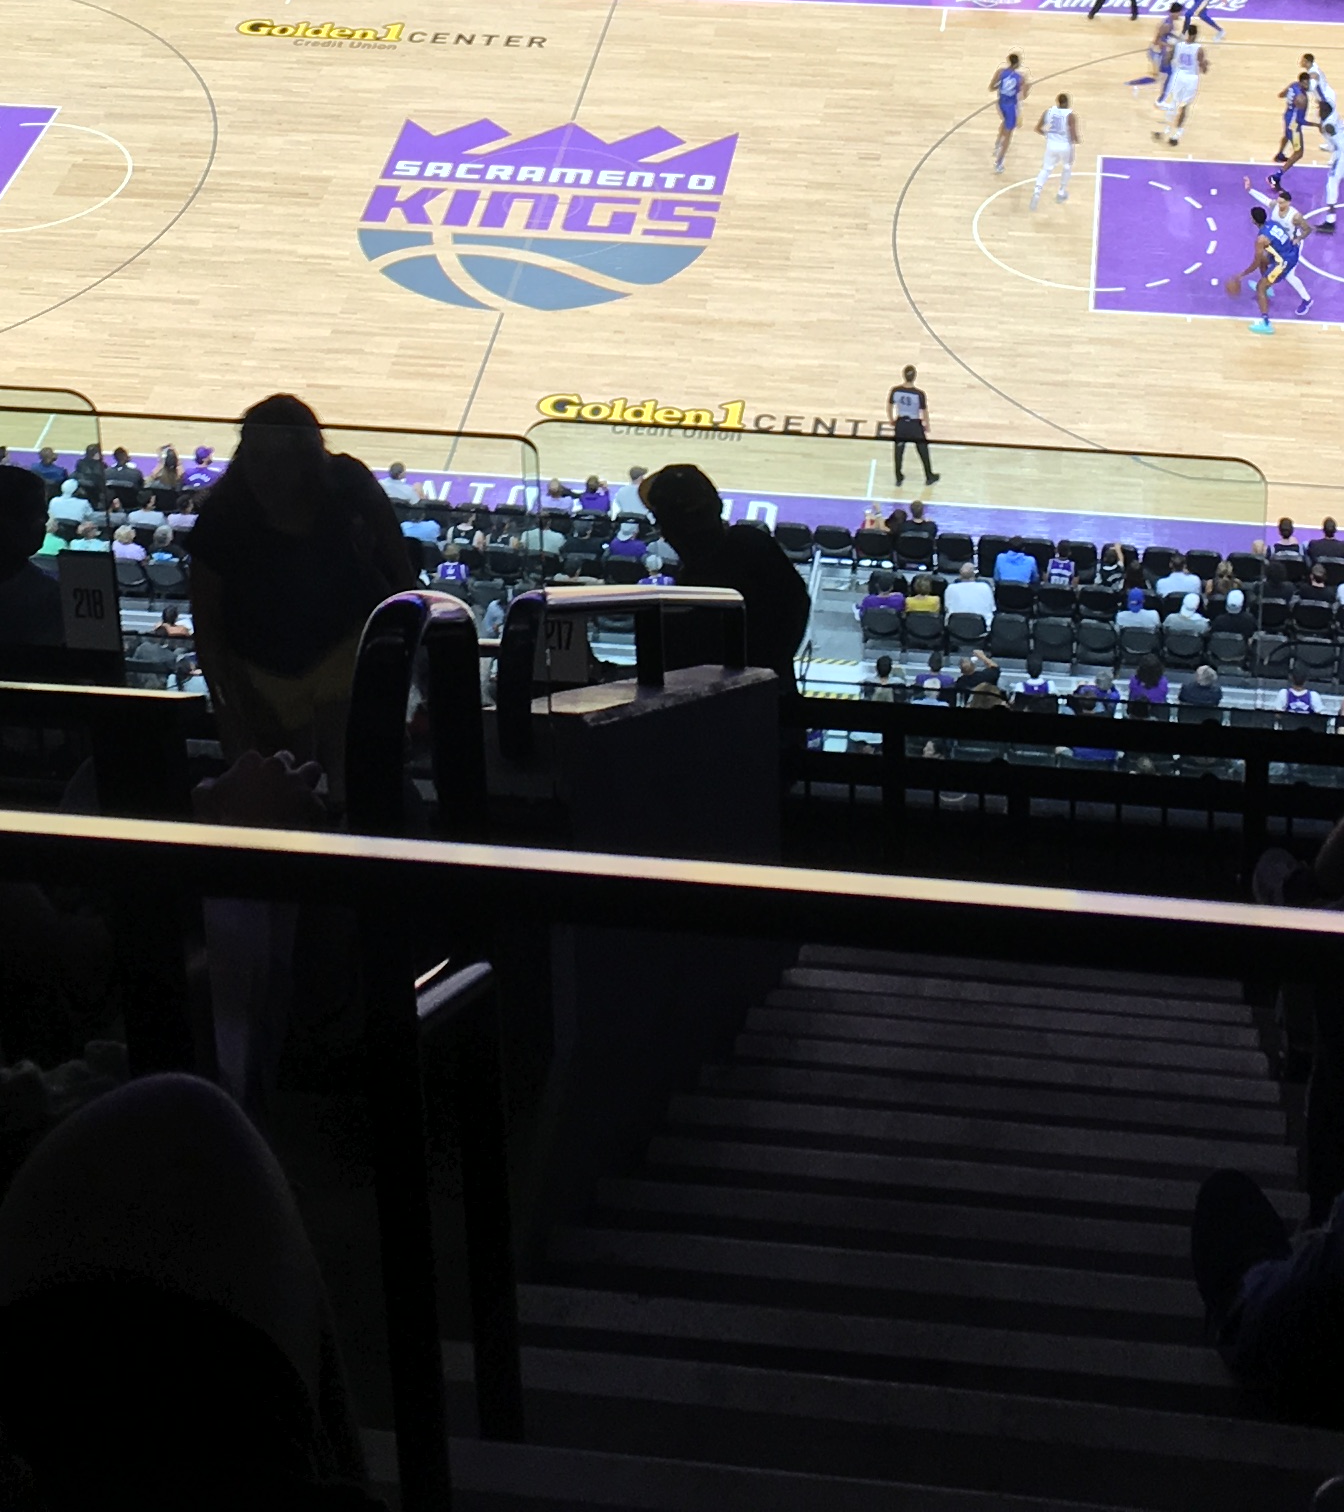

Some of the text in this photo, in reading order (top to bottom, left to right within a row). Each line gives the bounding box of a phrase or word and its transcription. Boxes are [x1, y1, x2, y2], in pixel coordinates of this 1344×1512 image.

[293, 38, 397, 51] Credit Union
[407, 31, 546, 48] CENTER
[393, 159, 716, 191] SACRAMENTO
[359, 184, 721, 239] KINGS
[753, 413, 894, 439] CENTE
